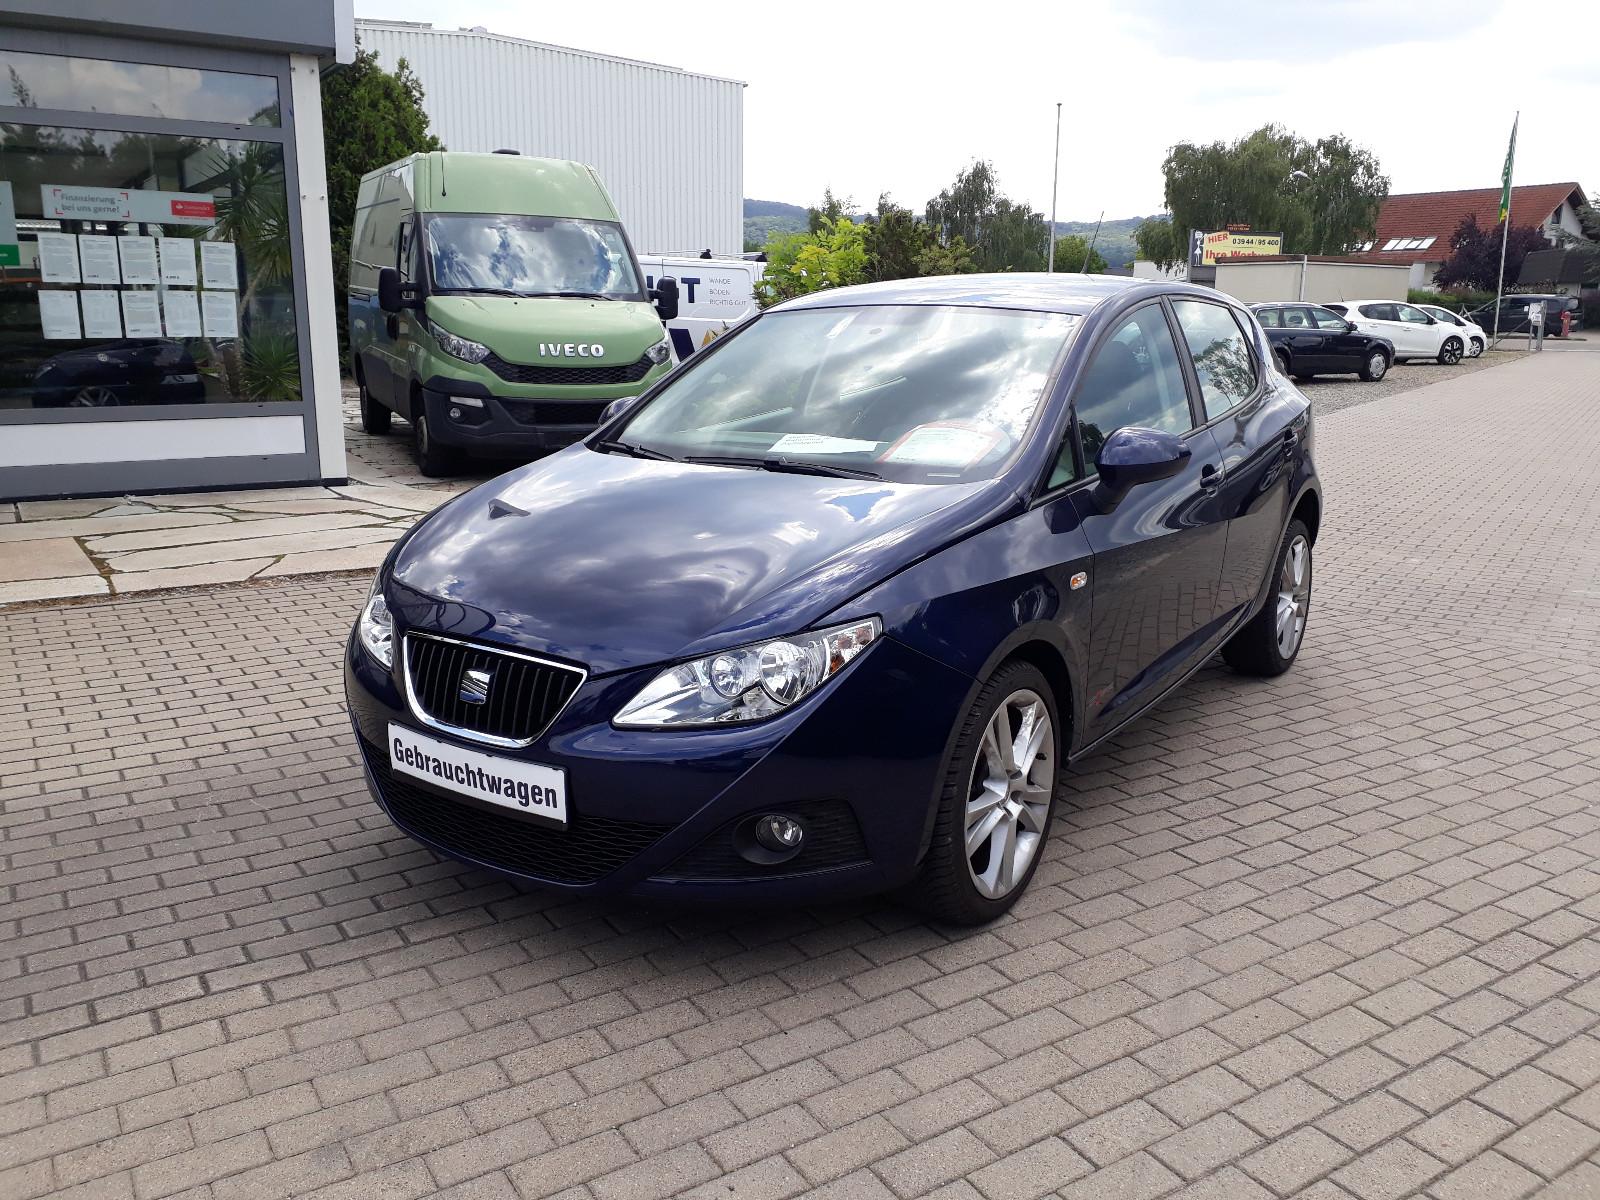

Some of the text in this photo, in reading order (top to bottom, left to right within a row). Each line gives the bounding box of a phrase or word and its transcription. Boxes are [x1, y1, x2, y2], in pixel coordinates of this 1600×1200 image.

[61, 193, 116, 205] Finanzierung
[93, 206, 120, 214] gerne!
[539, 343, 604, 357] IVECO
[393, 737, 558, 808] Gebrauchtwagen
